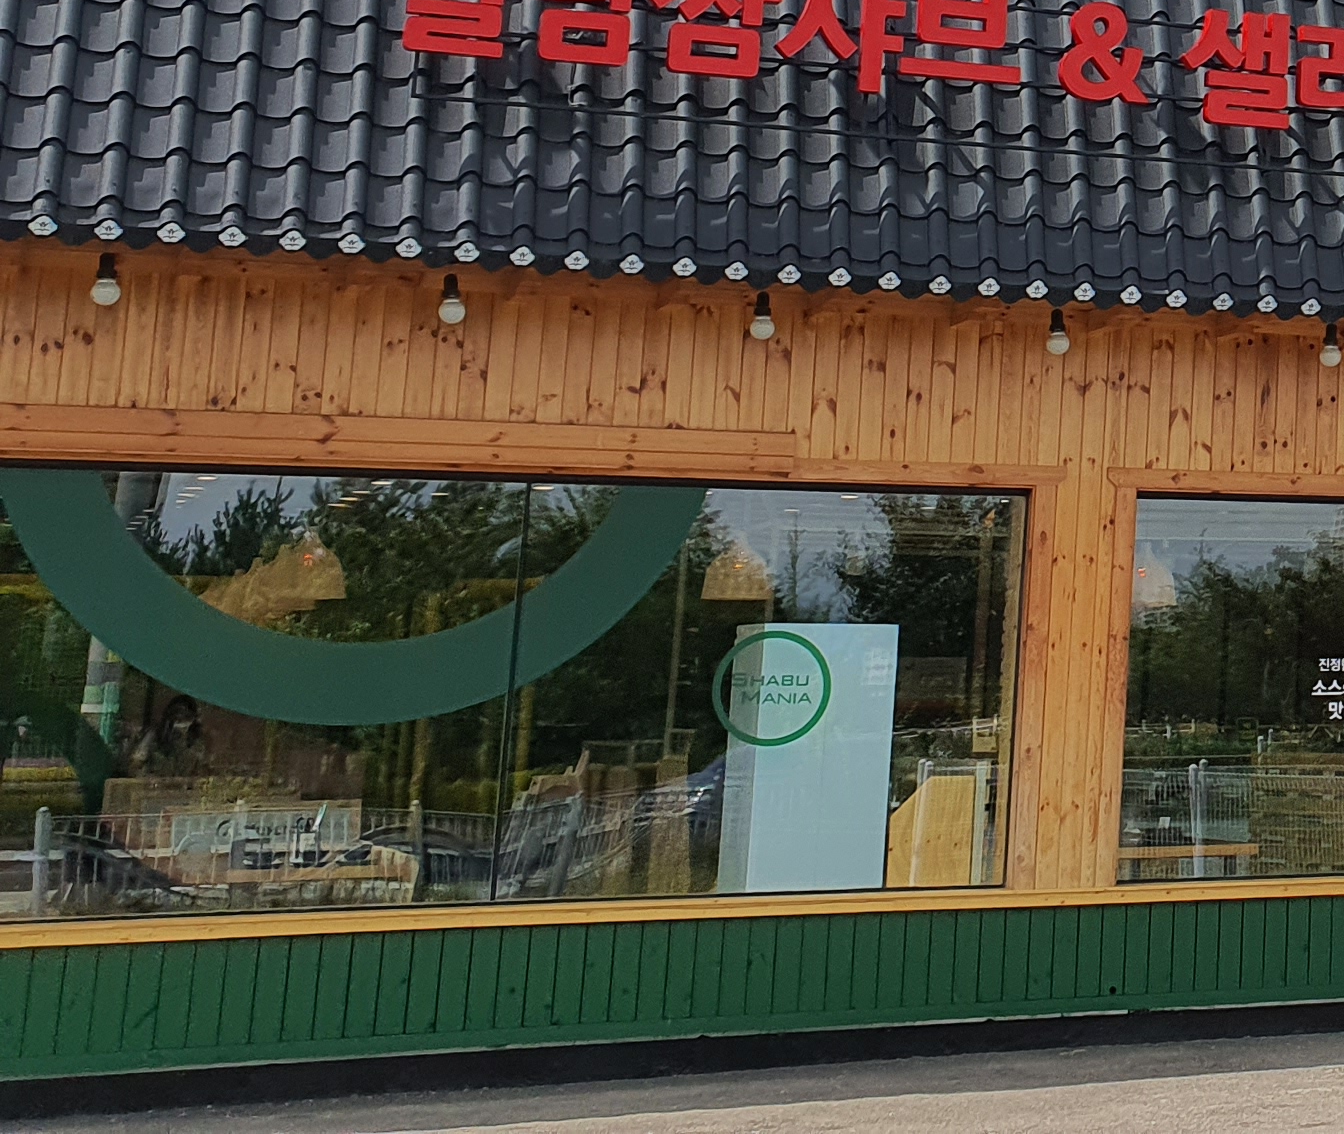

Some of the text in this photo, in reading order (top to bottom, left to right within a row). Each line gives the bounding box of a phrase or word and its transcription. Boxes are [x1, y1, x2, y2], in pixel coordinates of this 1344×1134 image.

[1058, 3, 1150, 106] &
[732, 672, 810, 687] SHABU
[739, 691, 813, 705] MANIA
[1328, 700, 1344, 720] 맛
